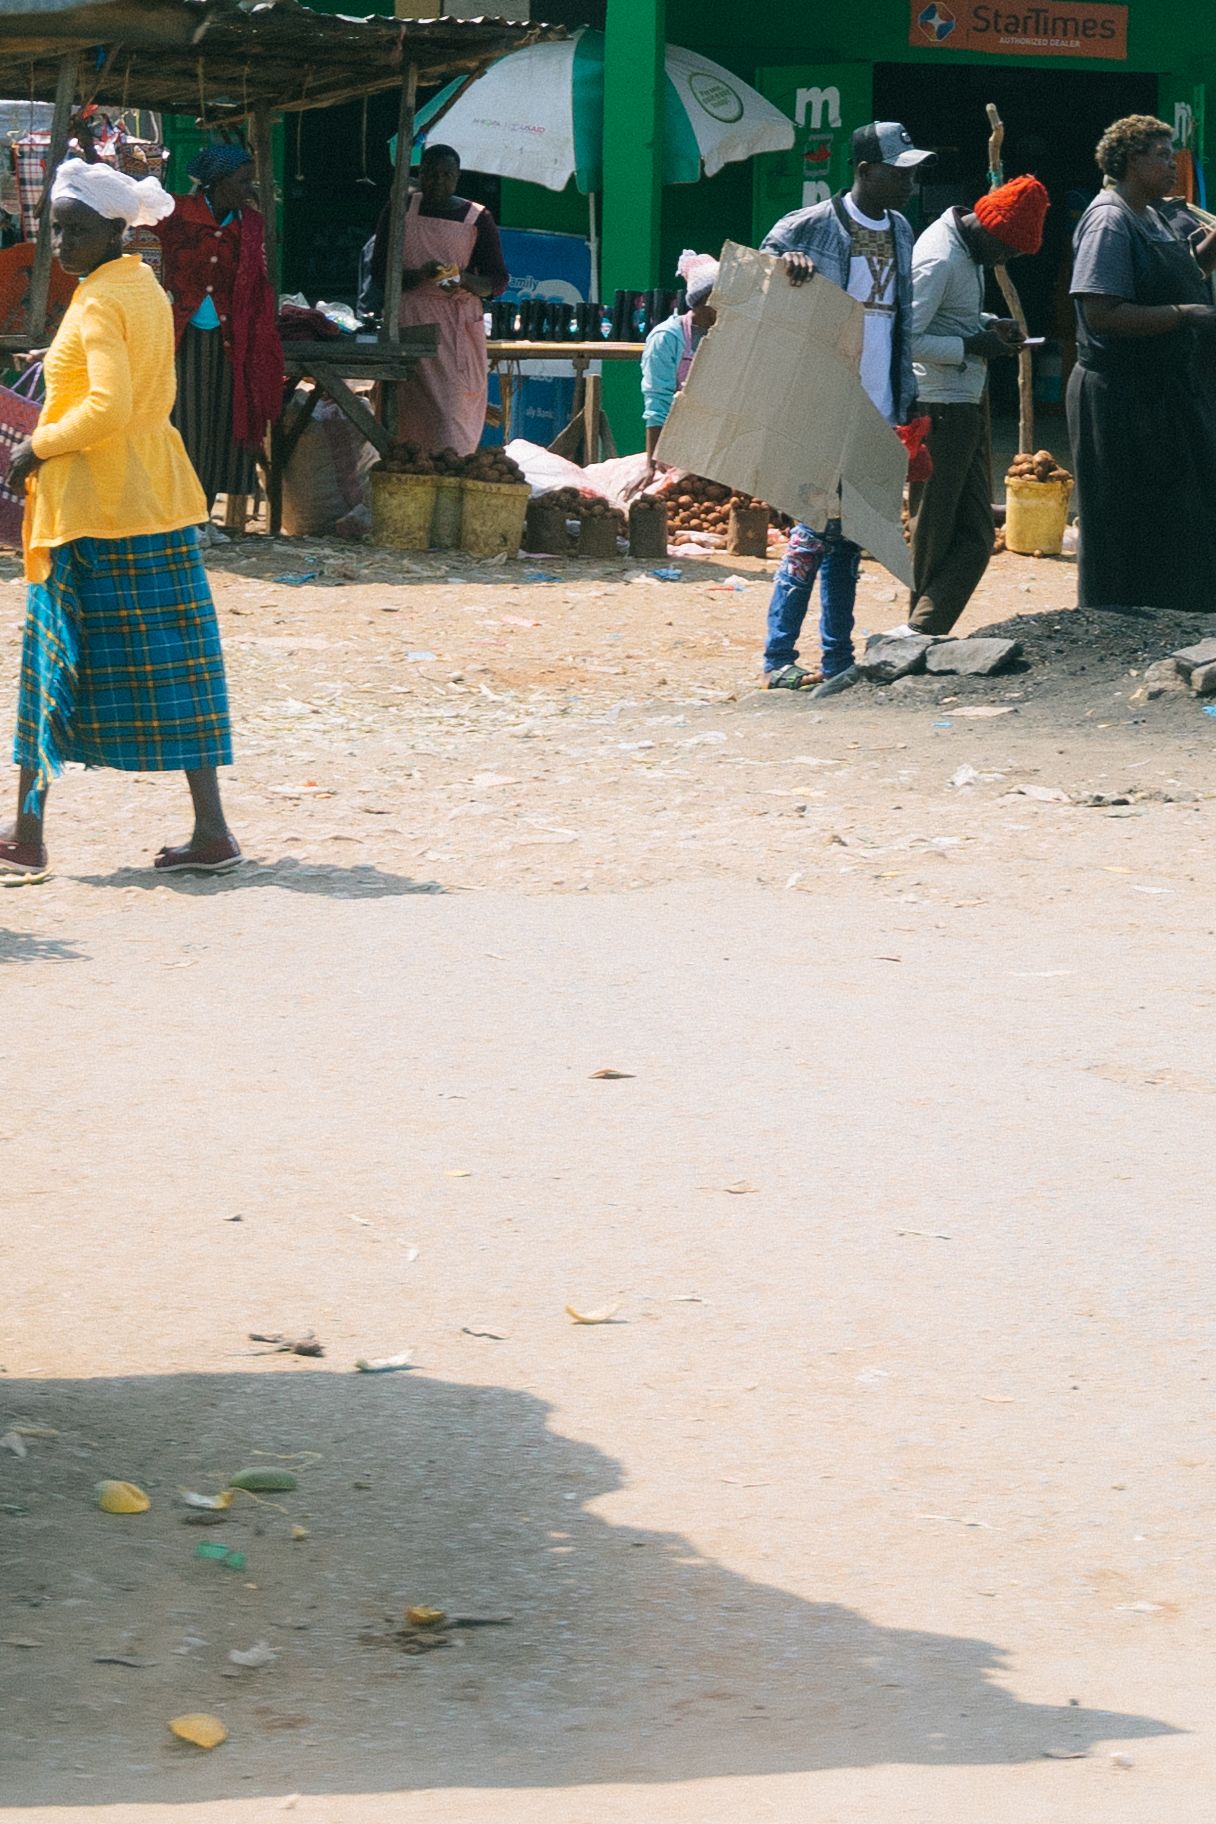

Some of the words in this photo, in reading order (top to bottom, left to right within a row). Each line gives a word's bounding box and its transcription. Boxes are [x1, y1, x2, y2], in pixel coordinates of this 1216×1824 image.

[971, 4, 1116, 40] StarTimes
[999, 36, 1049, 48] AUTHORIZED
[1050, 37, 1081, 49] DEALER
